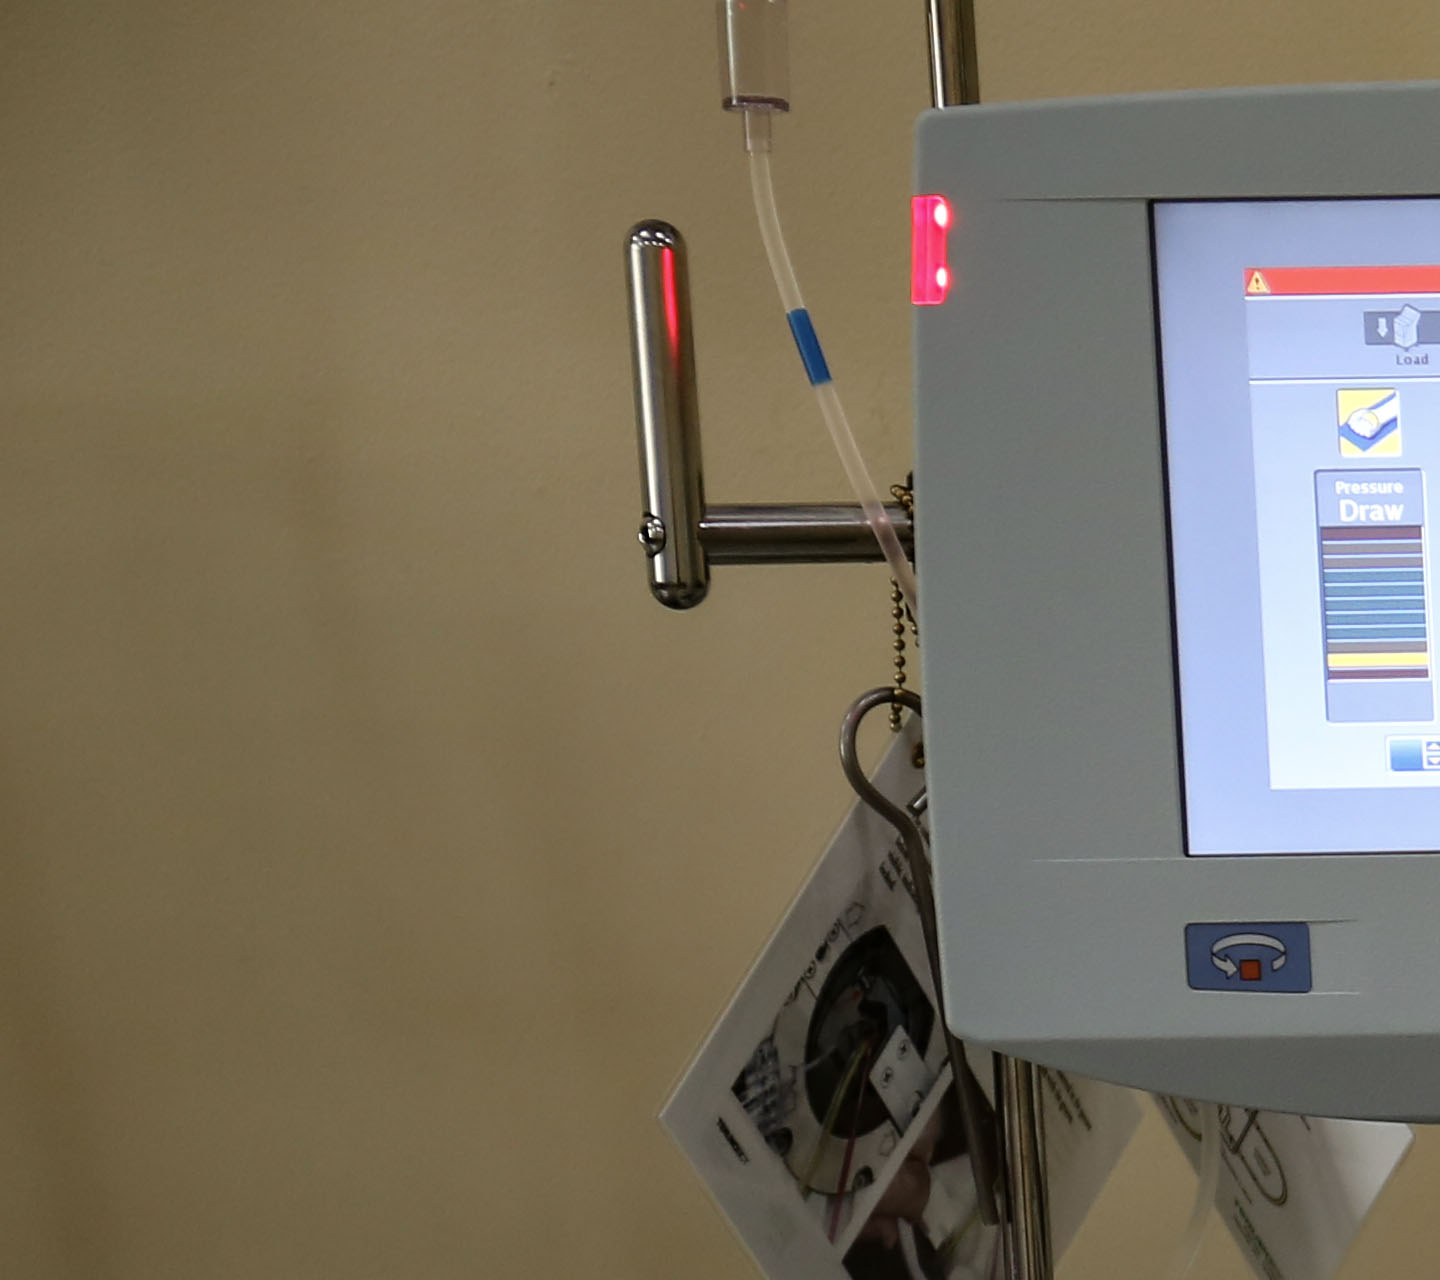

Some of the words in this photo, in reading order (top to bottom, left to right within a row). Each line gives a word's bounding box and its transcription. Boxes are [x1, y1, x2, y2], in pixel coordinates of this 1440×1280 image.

[1395, 353, 1430, 366] Load
[1335, 481, 1403, 495] Pressure
[1339, 499, 1403, 522] Draw
